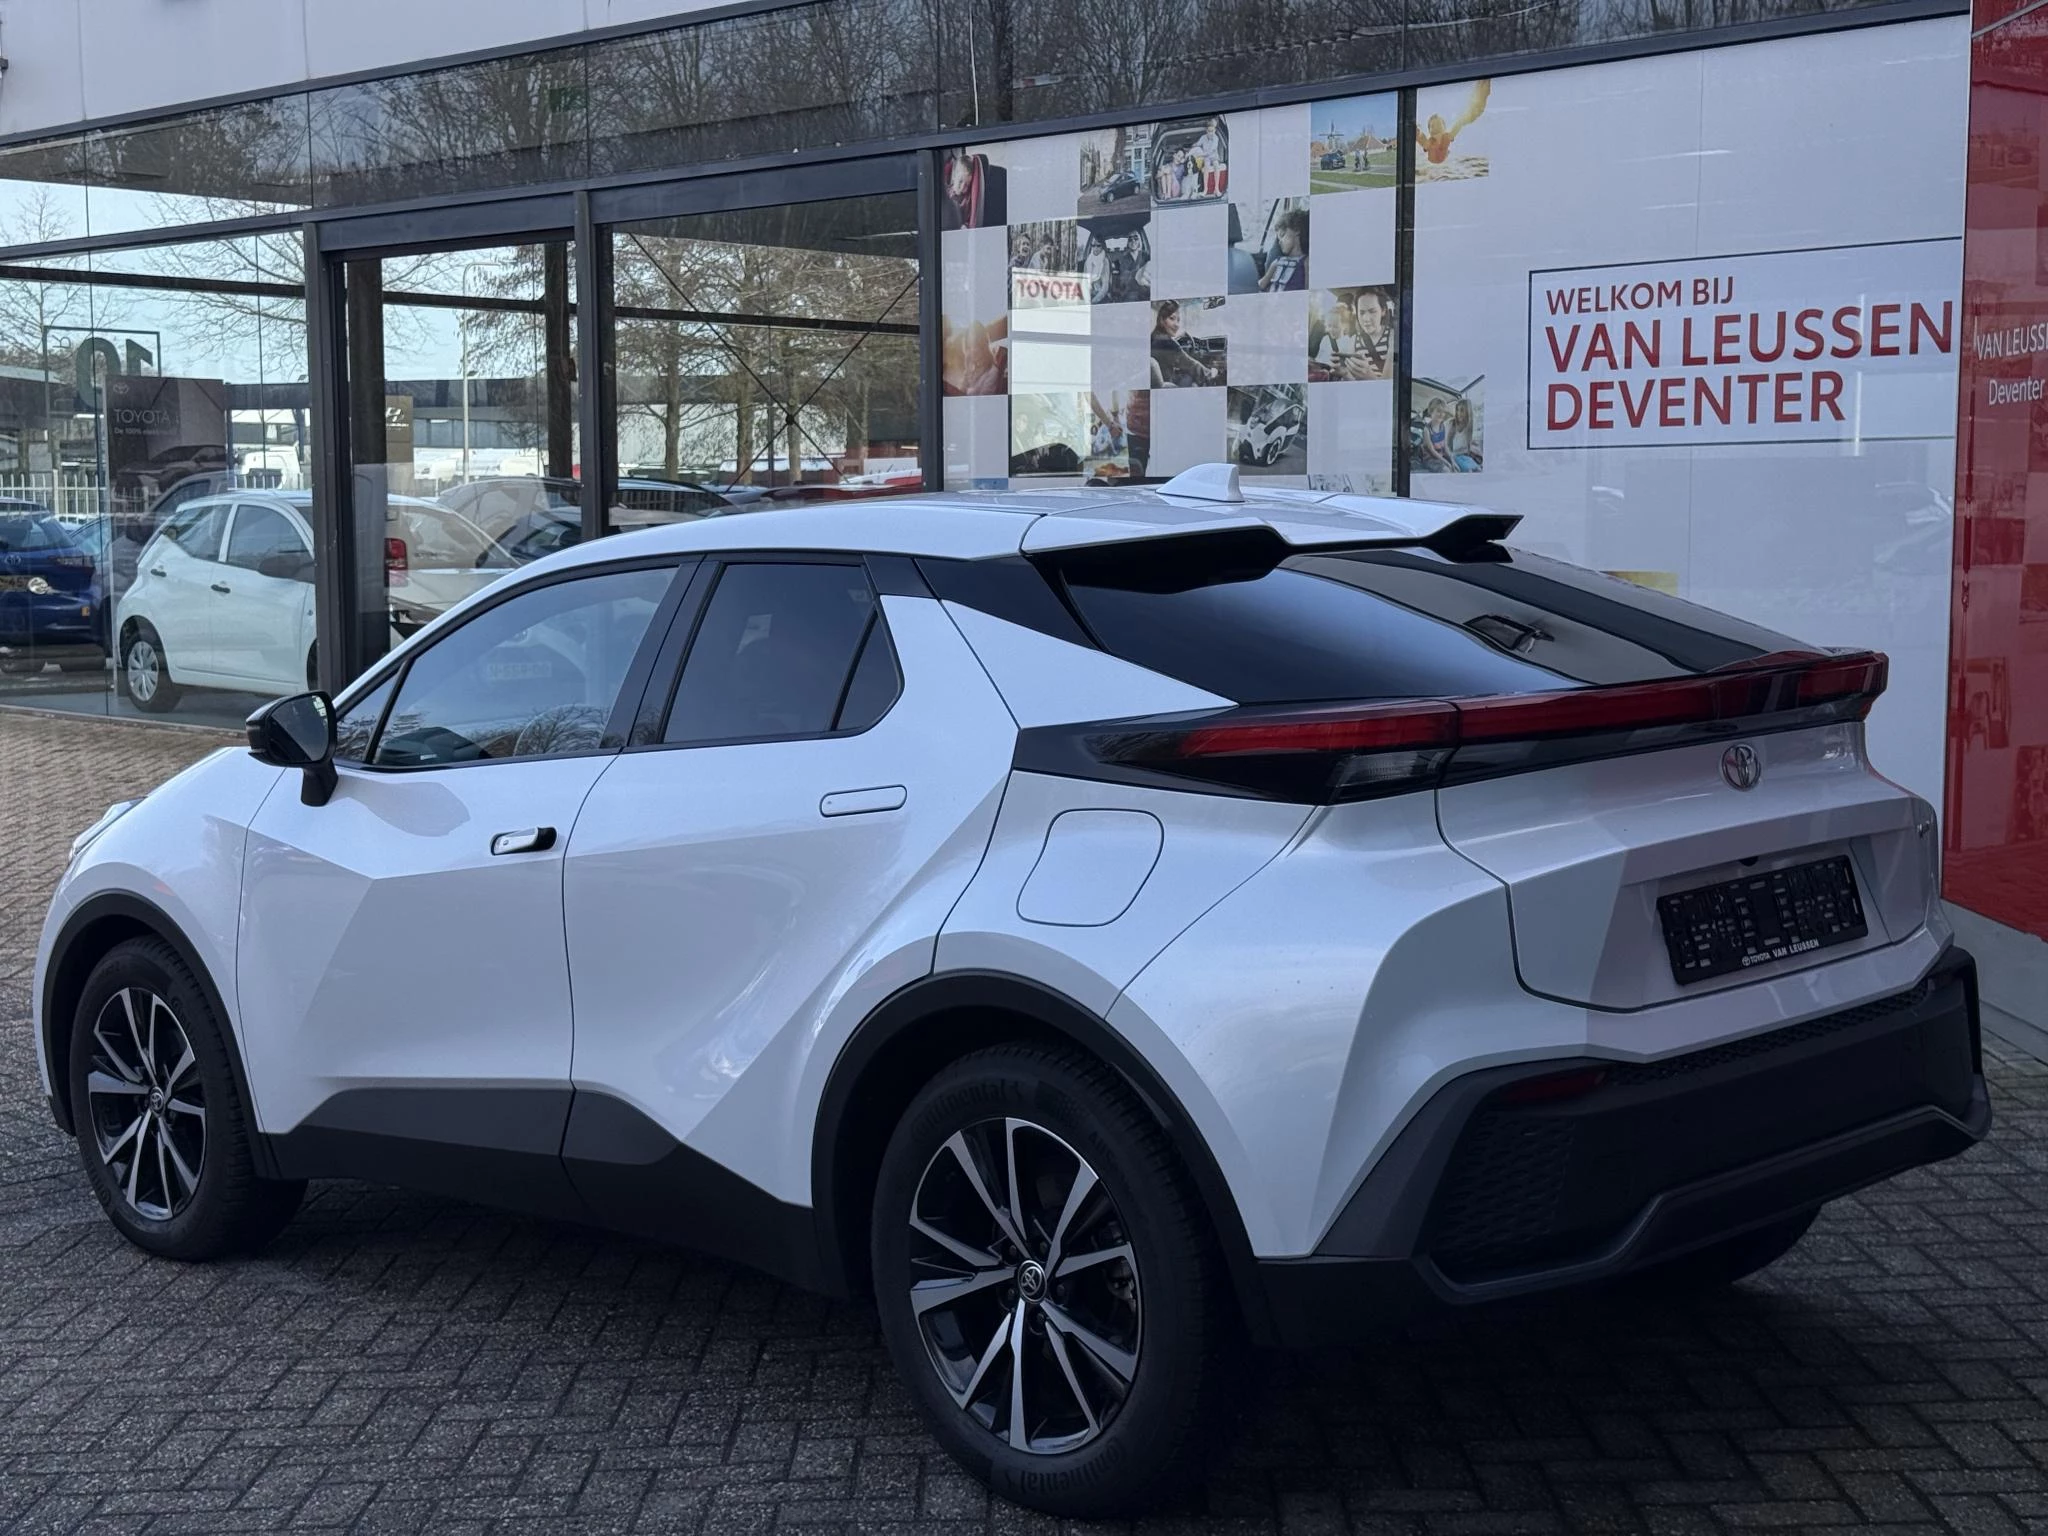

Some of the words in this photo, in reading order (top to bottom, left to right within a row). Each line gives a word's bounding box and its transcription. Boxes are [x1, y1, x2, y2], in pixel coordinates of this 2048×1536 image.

[1016, 279, 1085, 300] TOYOTA
[1546, 280, 1682, 316] WELKOM
[1693, 276, 1734, 306] BIJ
[1545, 319, 1661, 373] VAN
[1682, 301, 1953, 367] LEUSSEN
[1976, 331, 2003, 361] VAN
[2006, 322, 2048, 356] LEUSS
[1548, 371, 1845, 431] DEVENTER
[1988, 376, 2046, 405] Deventer
[113, 408, 171, 425] TOYOTA
[1750, 952, 1771, 964] TOYOTA
[1772, 947, 1788, 959] VAN
[1789, 938, 1820, 954] LEUSSEN
